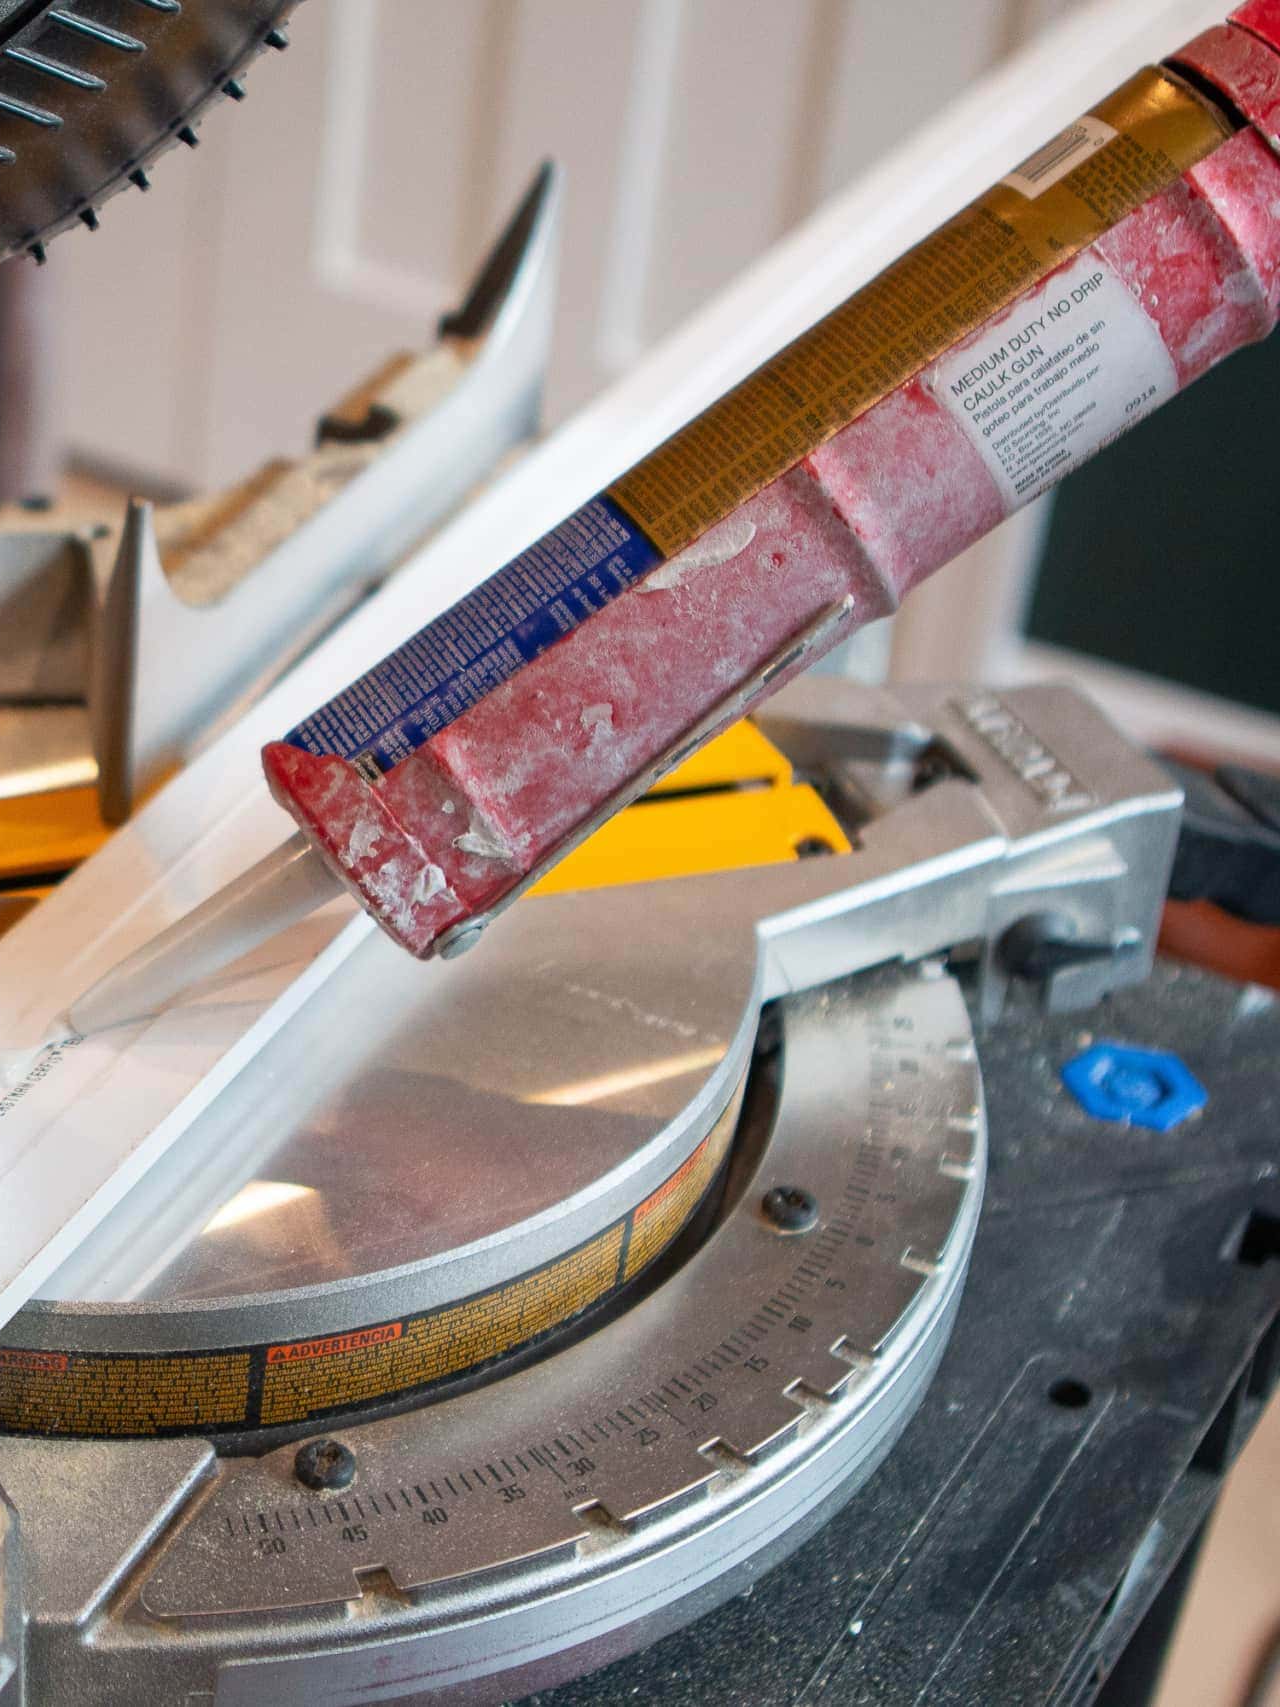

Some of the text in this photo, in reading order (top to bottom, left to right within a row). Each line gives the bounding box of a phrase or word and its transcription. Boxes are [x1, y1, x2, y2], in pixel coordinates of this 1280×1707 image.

[951, 272, 1102, 396] MEDIUM DUTY NO DRIP
[964, 345, 1044, 411] CAULK GUN
[972, 321, 1105, 424] Pistola para calafateo de sin
[982, 344, 1099, 437] goteo para trabajo medio
[824, 1277, 846, 1290] 5
[787, 1315, 813, 1333] 10
[288, 1327, 396, 1358] ADVERTENCIA
[743, 1353, 769, 1373] 15
[689, 1391, 718, 1412] 20
[632, 1426, 660, 1446] 25
[566, 1456, 596, 1477] 30
[497, 1482, 526, 1503] 35
[422, 1506, 449, 1526] 40
[341, 1523, 369, 1543] 45
[258, 1536, 286, 1555] 50
